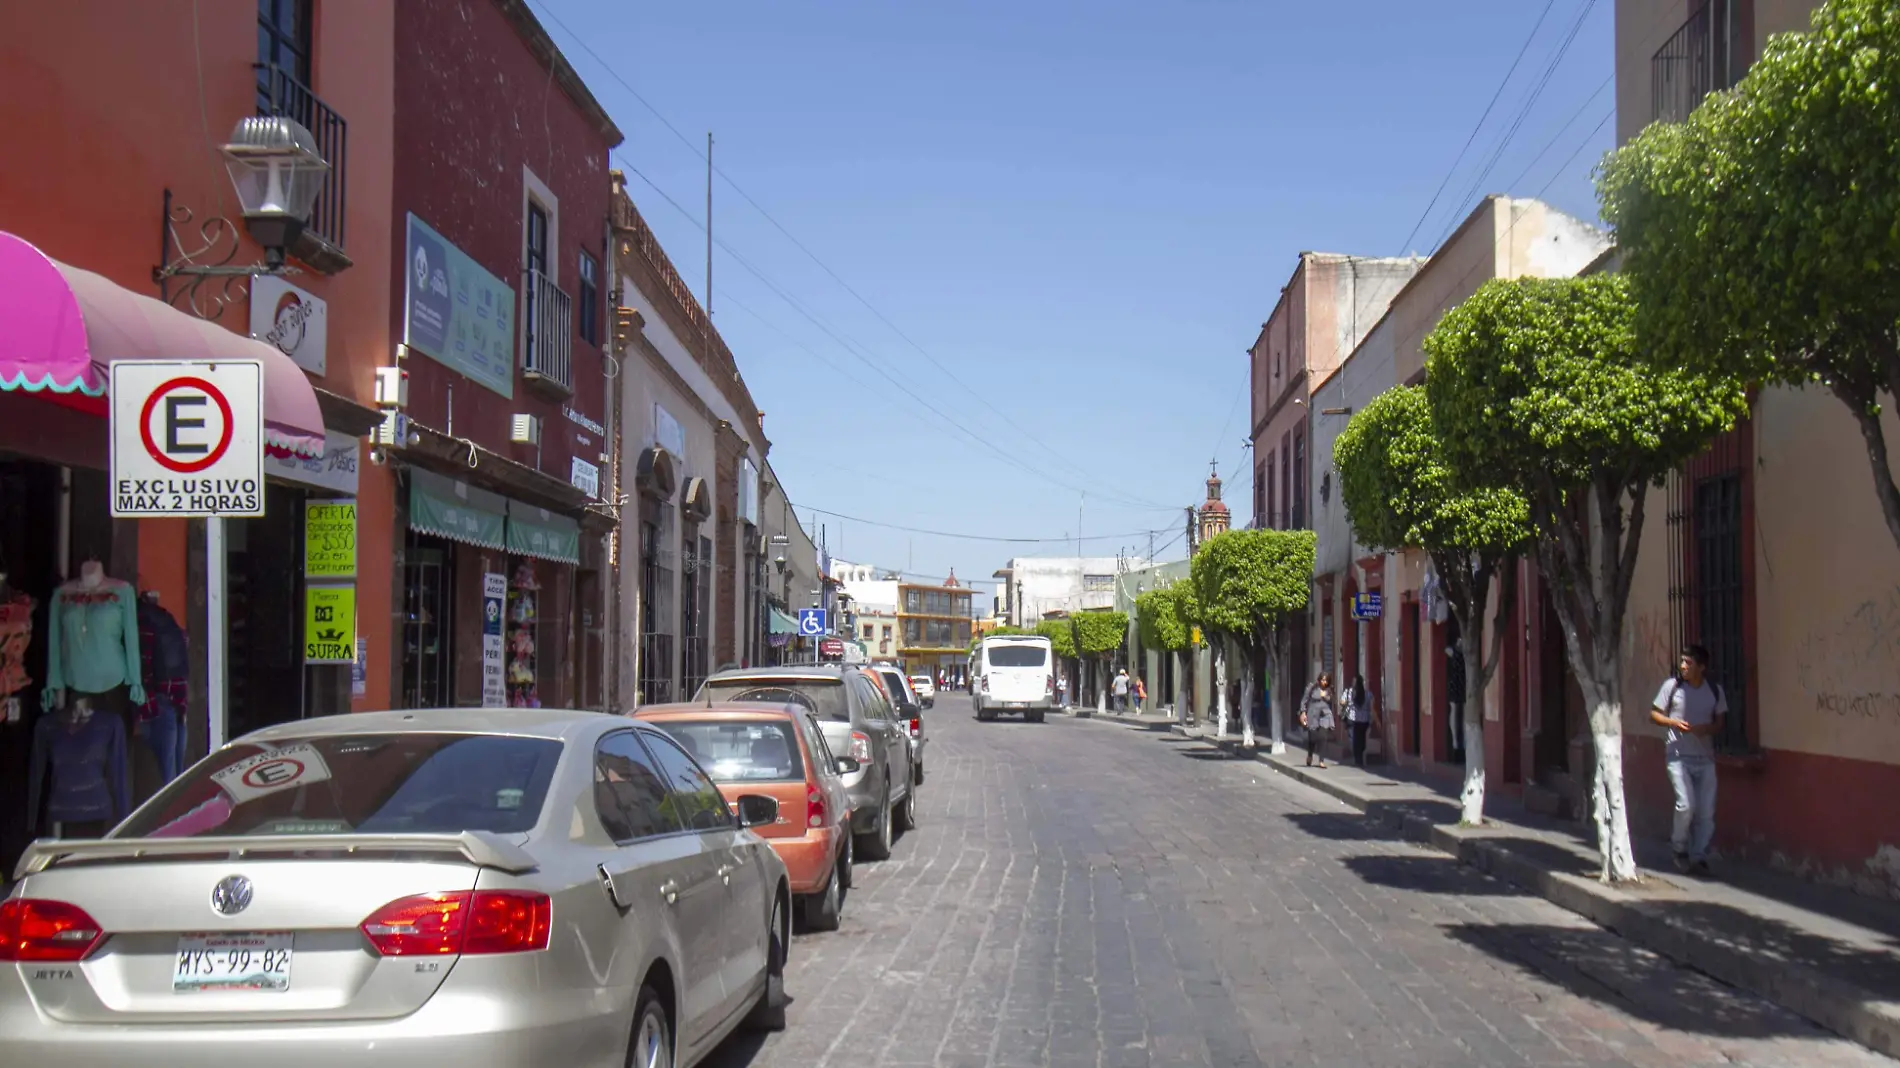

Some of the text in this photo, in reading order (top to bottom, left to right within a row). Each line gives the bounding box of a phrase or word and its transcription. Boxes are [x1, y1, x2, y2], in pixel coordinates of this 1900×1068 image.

[166, 396, 208, 453] E
[119, 479, 256, 494] EXCLUSIVO
[119, 495, 257, 510] MAX. 2 HORAS
[307, 505, 356, 520] OFERTA
[307, 643, 353, 659] SUPRA
[178, 949, 289, 975] MYS-99-82
[35, 969, 74, 980] JETTA
